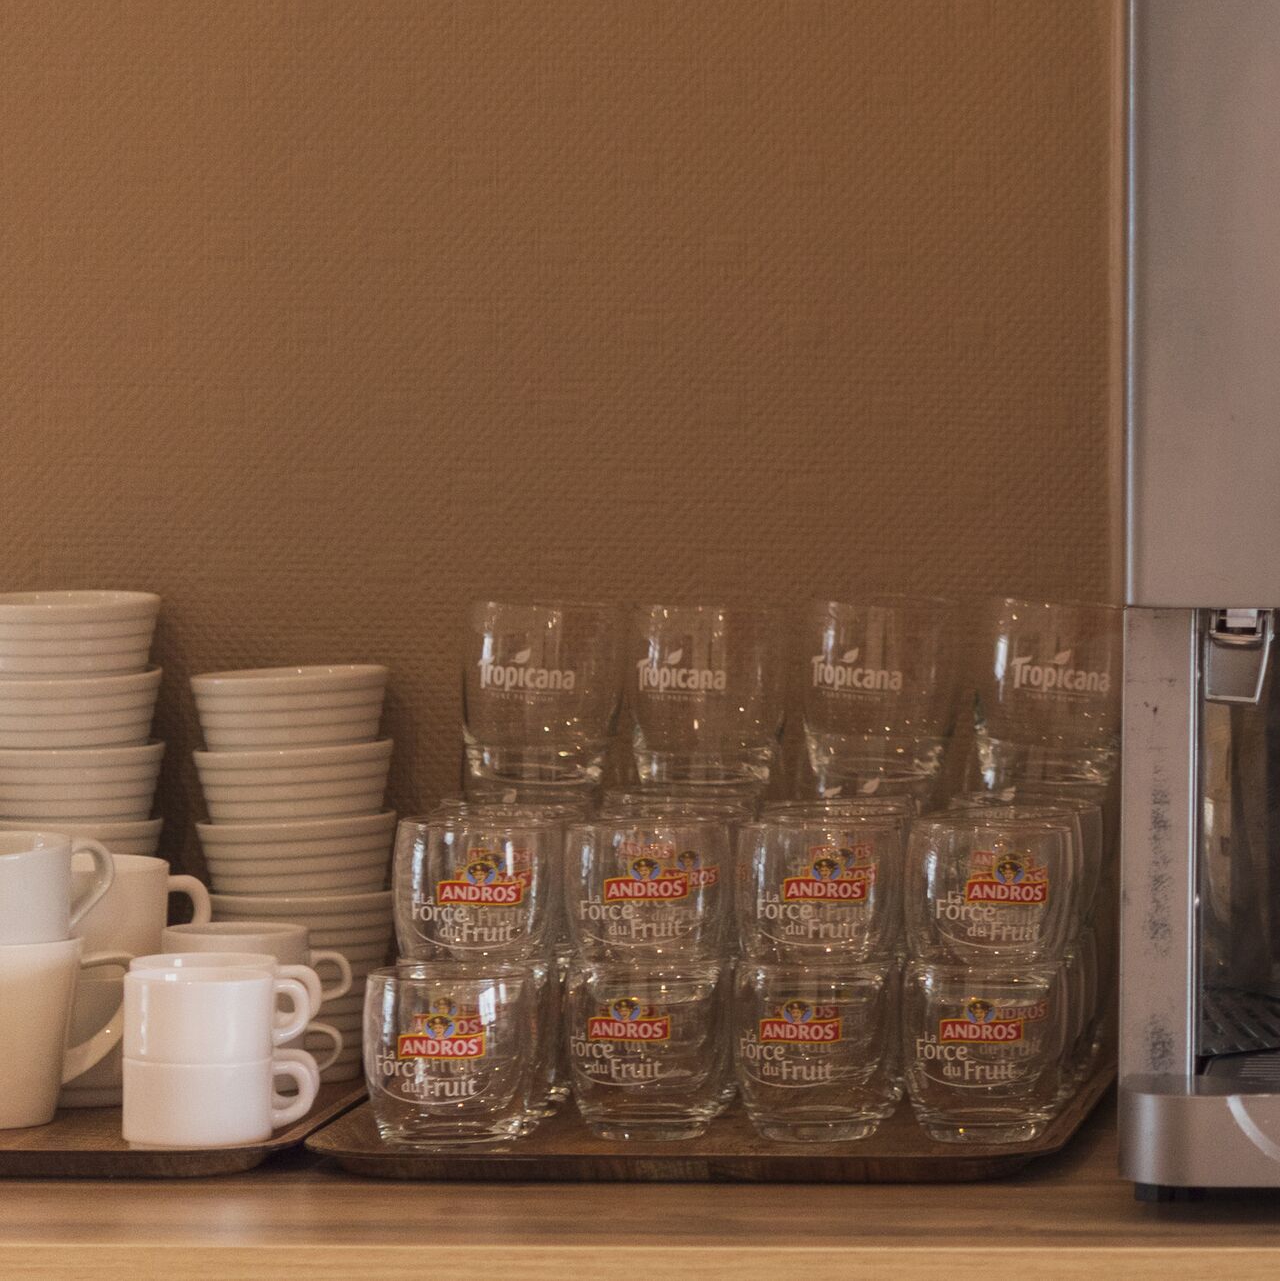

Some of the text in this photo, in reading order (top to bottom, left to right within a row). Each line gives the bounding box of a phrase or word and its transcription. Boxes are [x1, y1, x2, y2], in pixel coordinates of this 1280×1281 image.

[477, 657, 576, 692] Tropicana
[636, 658, 727, 693] Tropicana
[811, 655, 903, 691] Tropicana
[1010, 655, 1111, 692] Tropicana
[440, 885, 518, 903] ANDROS
[588, 893, 601, 904] La
[607, 879, 684, 898] ANDROS
[766, 891, 780, 903] La
[786, 882, 863, 898] ANDROS
[947, 891, 962, 904] La
[969, 884, 1044, 901] ANDROS
[421, 893, 434, 905] La
[579, 900, 634, 920] Force
[757, 899, 813, 920] Force
[935, 899, 995, 920] Force
[440, 921, 514, 942] du Fruit
[607, 918, 683, 939] du Fruit
[785, 919, 861, 939] du Fruit
[966, 920, 1041, 942] du Fruit
[575, 1029, 586, 1041] La
[590, 1021, 664, 1039] ANDROS
[745, 1029, 757, 1043] La
[762, 1023, 835, 1040] ANDROS
[924, 1031, 937, 1044] La
[942, 1023, 1018, 1040] ANDROS
[383, 1046, 395, 1059] La
[401, 1038, 479, 1056] ANDROS
[569, 1036, 615, 1059] Force
[739, 1037, 785, 1060] Force
[916, 1038, 968, 1061] Force
[592, 1057, 663, 1079] du Fruit
[761, 1059, 834, 1081] du Fruit
[942, 1059, 1017, 1081] du Fruit
[401, 1076, 478, 1098] du Fruit
